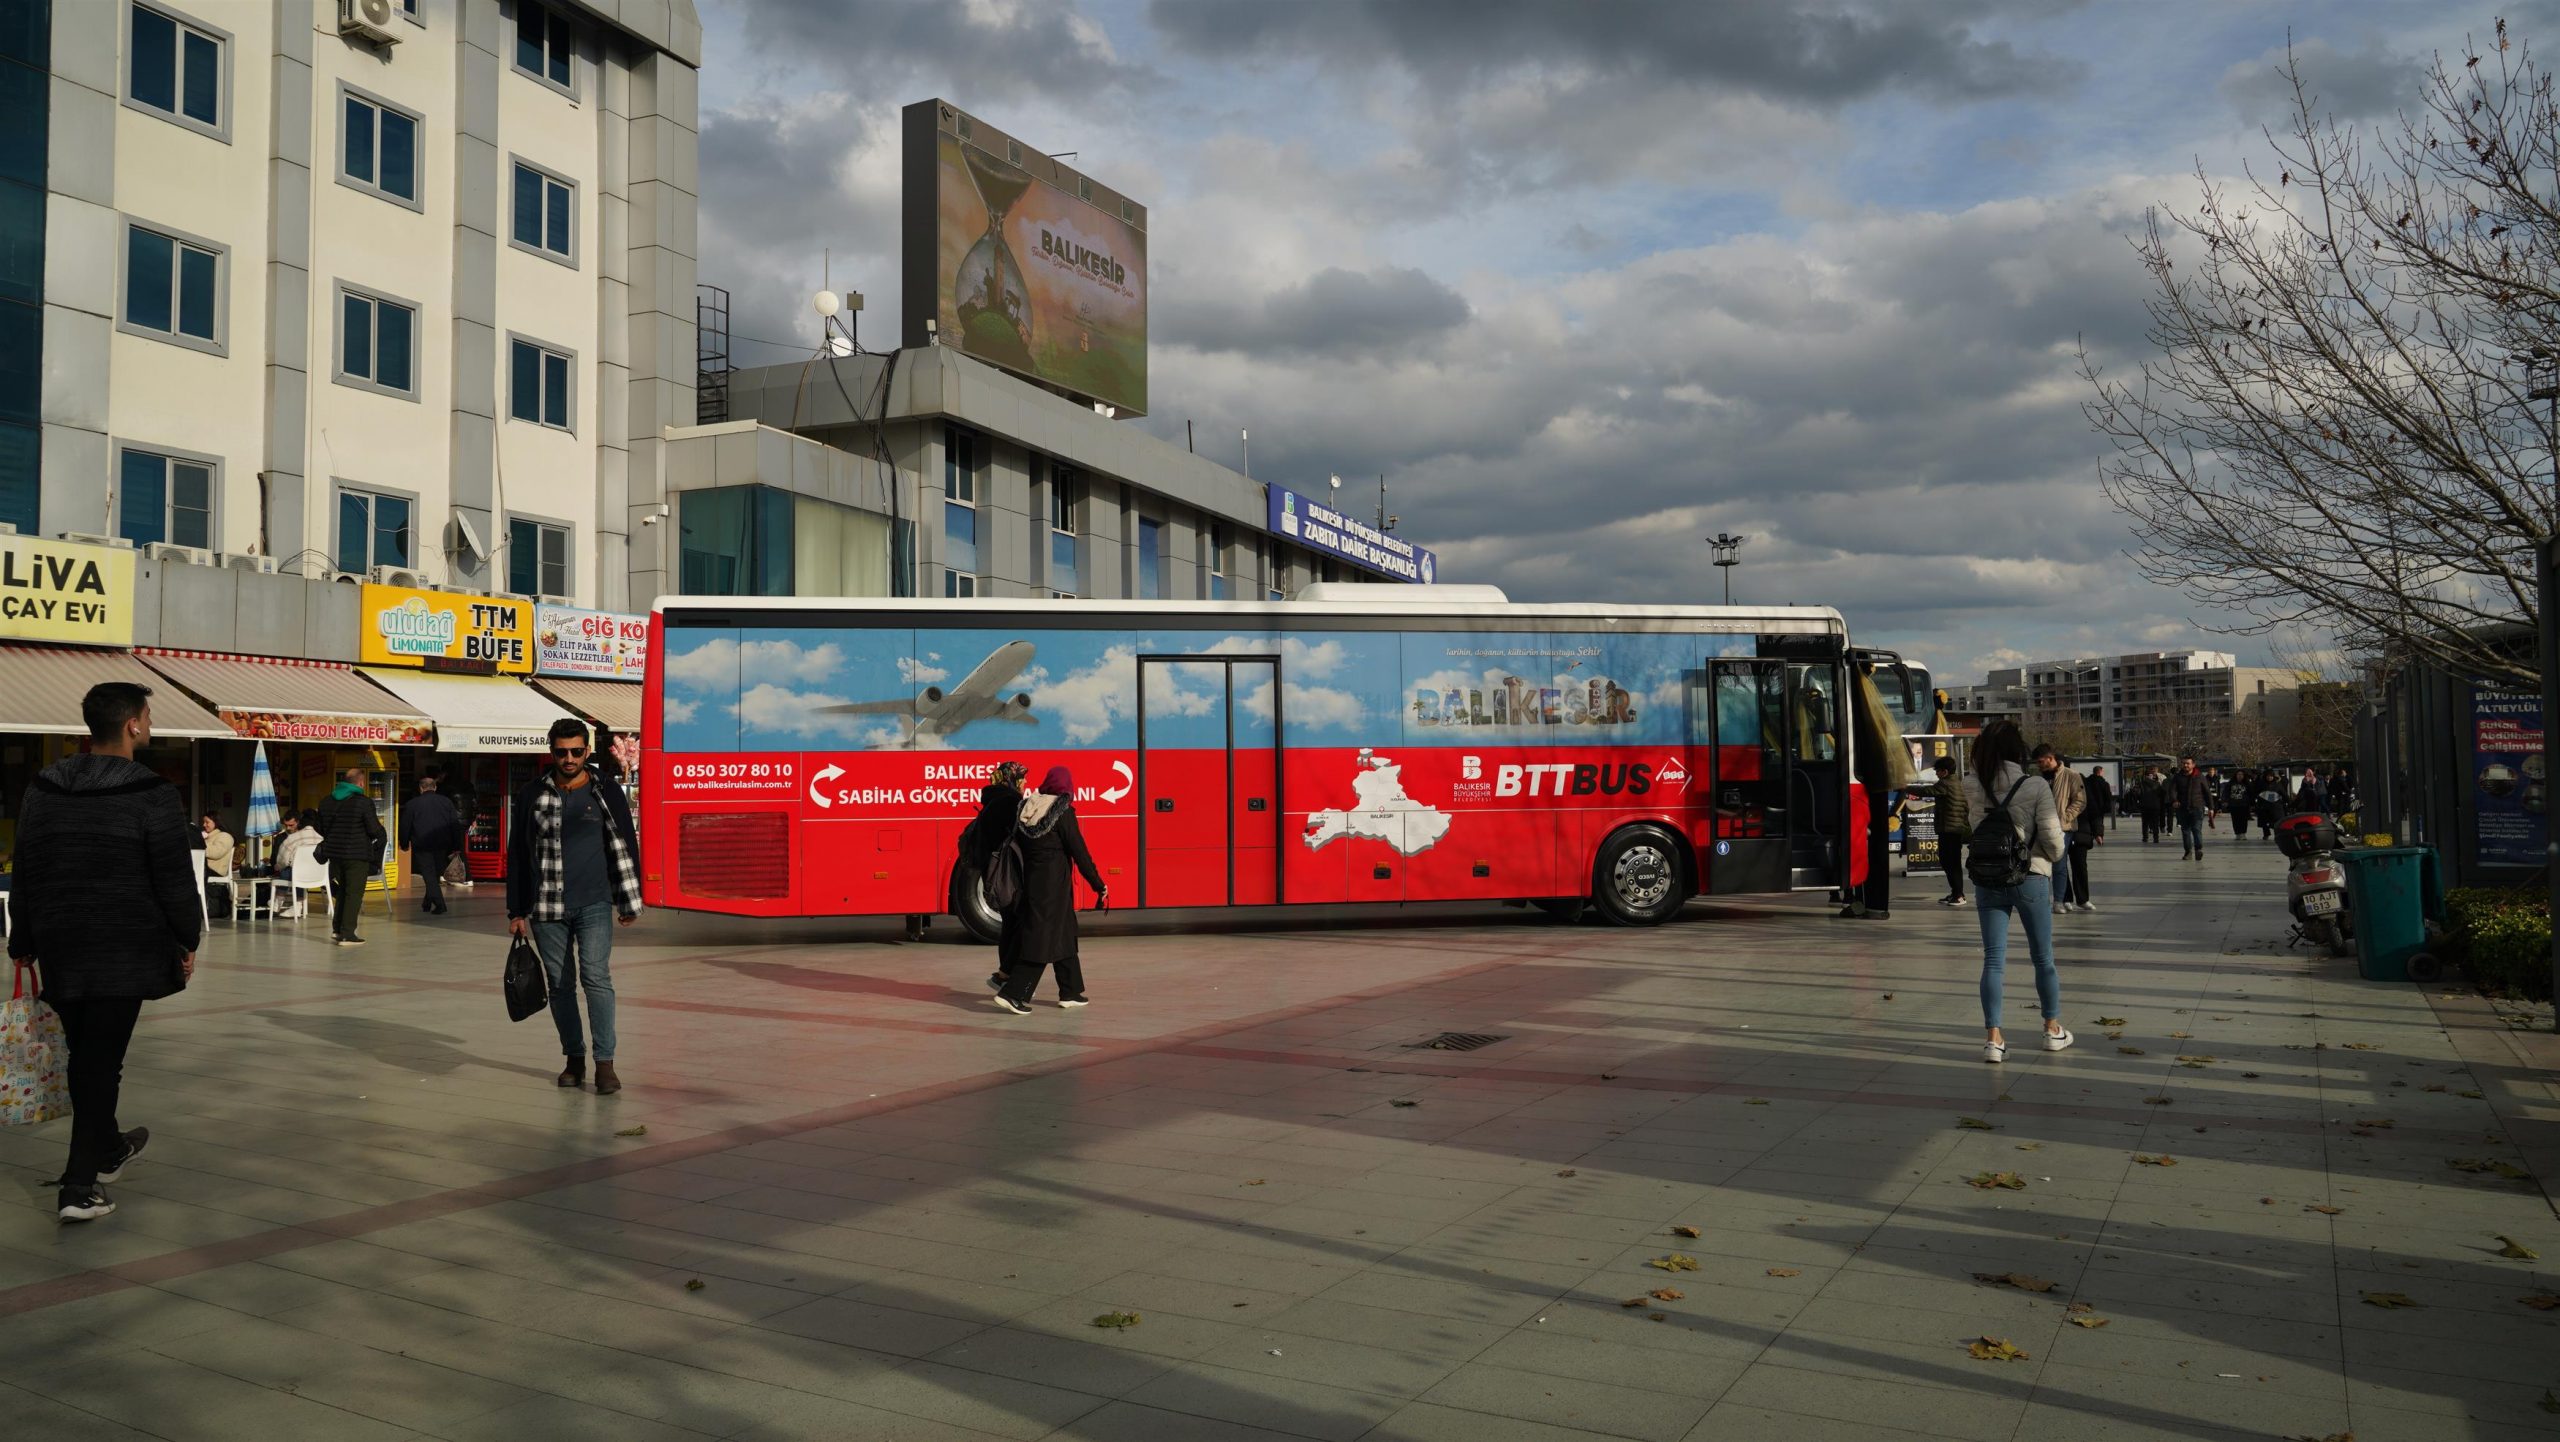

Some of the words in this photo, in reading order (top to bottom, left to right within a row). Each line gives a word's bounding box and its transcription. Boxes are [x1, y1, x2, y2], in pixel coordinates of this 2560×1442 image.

[1041, 229, 1125, 286] BALIKESİR
[1308, 503, 1343, 529] BALIKESİR
[1344, 517, 1382, 545] BÜYÜKŞEHİR
[1382, 535, 1414, 558] BELEDİYESİ
[1303, 520, 1340, 550] ZABITA
[1340, 535, 1369, 561] DAİRE
[1369, 547, 1417, 579] BAŞKANLIĞI
[2, 596, 58, 620] ÇAY
[471, 604, 516, 629] TTM
[382, 607, 455, 643] uludağ
[582, 615, 615, 638] ÇİĞ
[620, 621, 650, 640] KÖ
[466, 631, 523, 661] BÜFE
[560, 640, 577, 651] ELİT
[578, 642, 598, 652] PARK
[543, 650, 569, 661] SOKAK
[571, 652, 613, 664] LEZZETLERİ
[625, 657, 645, 668] LAH
[272, 722, 337, 738] TRABZON
[2479, 721, 2517, 730] Sultan
[479, 734, 527, 746] KURUYEMİŞ
[529, 738, 551, 746] SARA
[2480, 731, 2543, 741] Abdülhami
[2480, 743, 2524, 752] Gelişim
[2525, 743, 2544, 751] Me
[673, 765, 683, 777] 0
[686, 765, 715, 777] 850
[719, 764, 746, 776] 307
[750, 764, 770, 777] 80
[774, 764, 792, 776] 10
[924, 765, 1000, 780] BALIKES
[1453, 782, 1491, 791] BALIKESİR
[838, 785, 905, 804] SABİHA
[909, 786, 982, 807] GÖKÇEN
[1453, 790, 1491, 798] BÜYÜKŞEHİR
[1919, 841, 1939, 852] HOŞ
[2304, 895, 2315, 903] 10
[2319, 892, 2336, 901] AJT
[2313, 902, 2331, 911] 613
